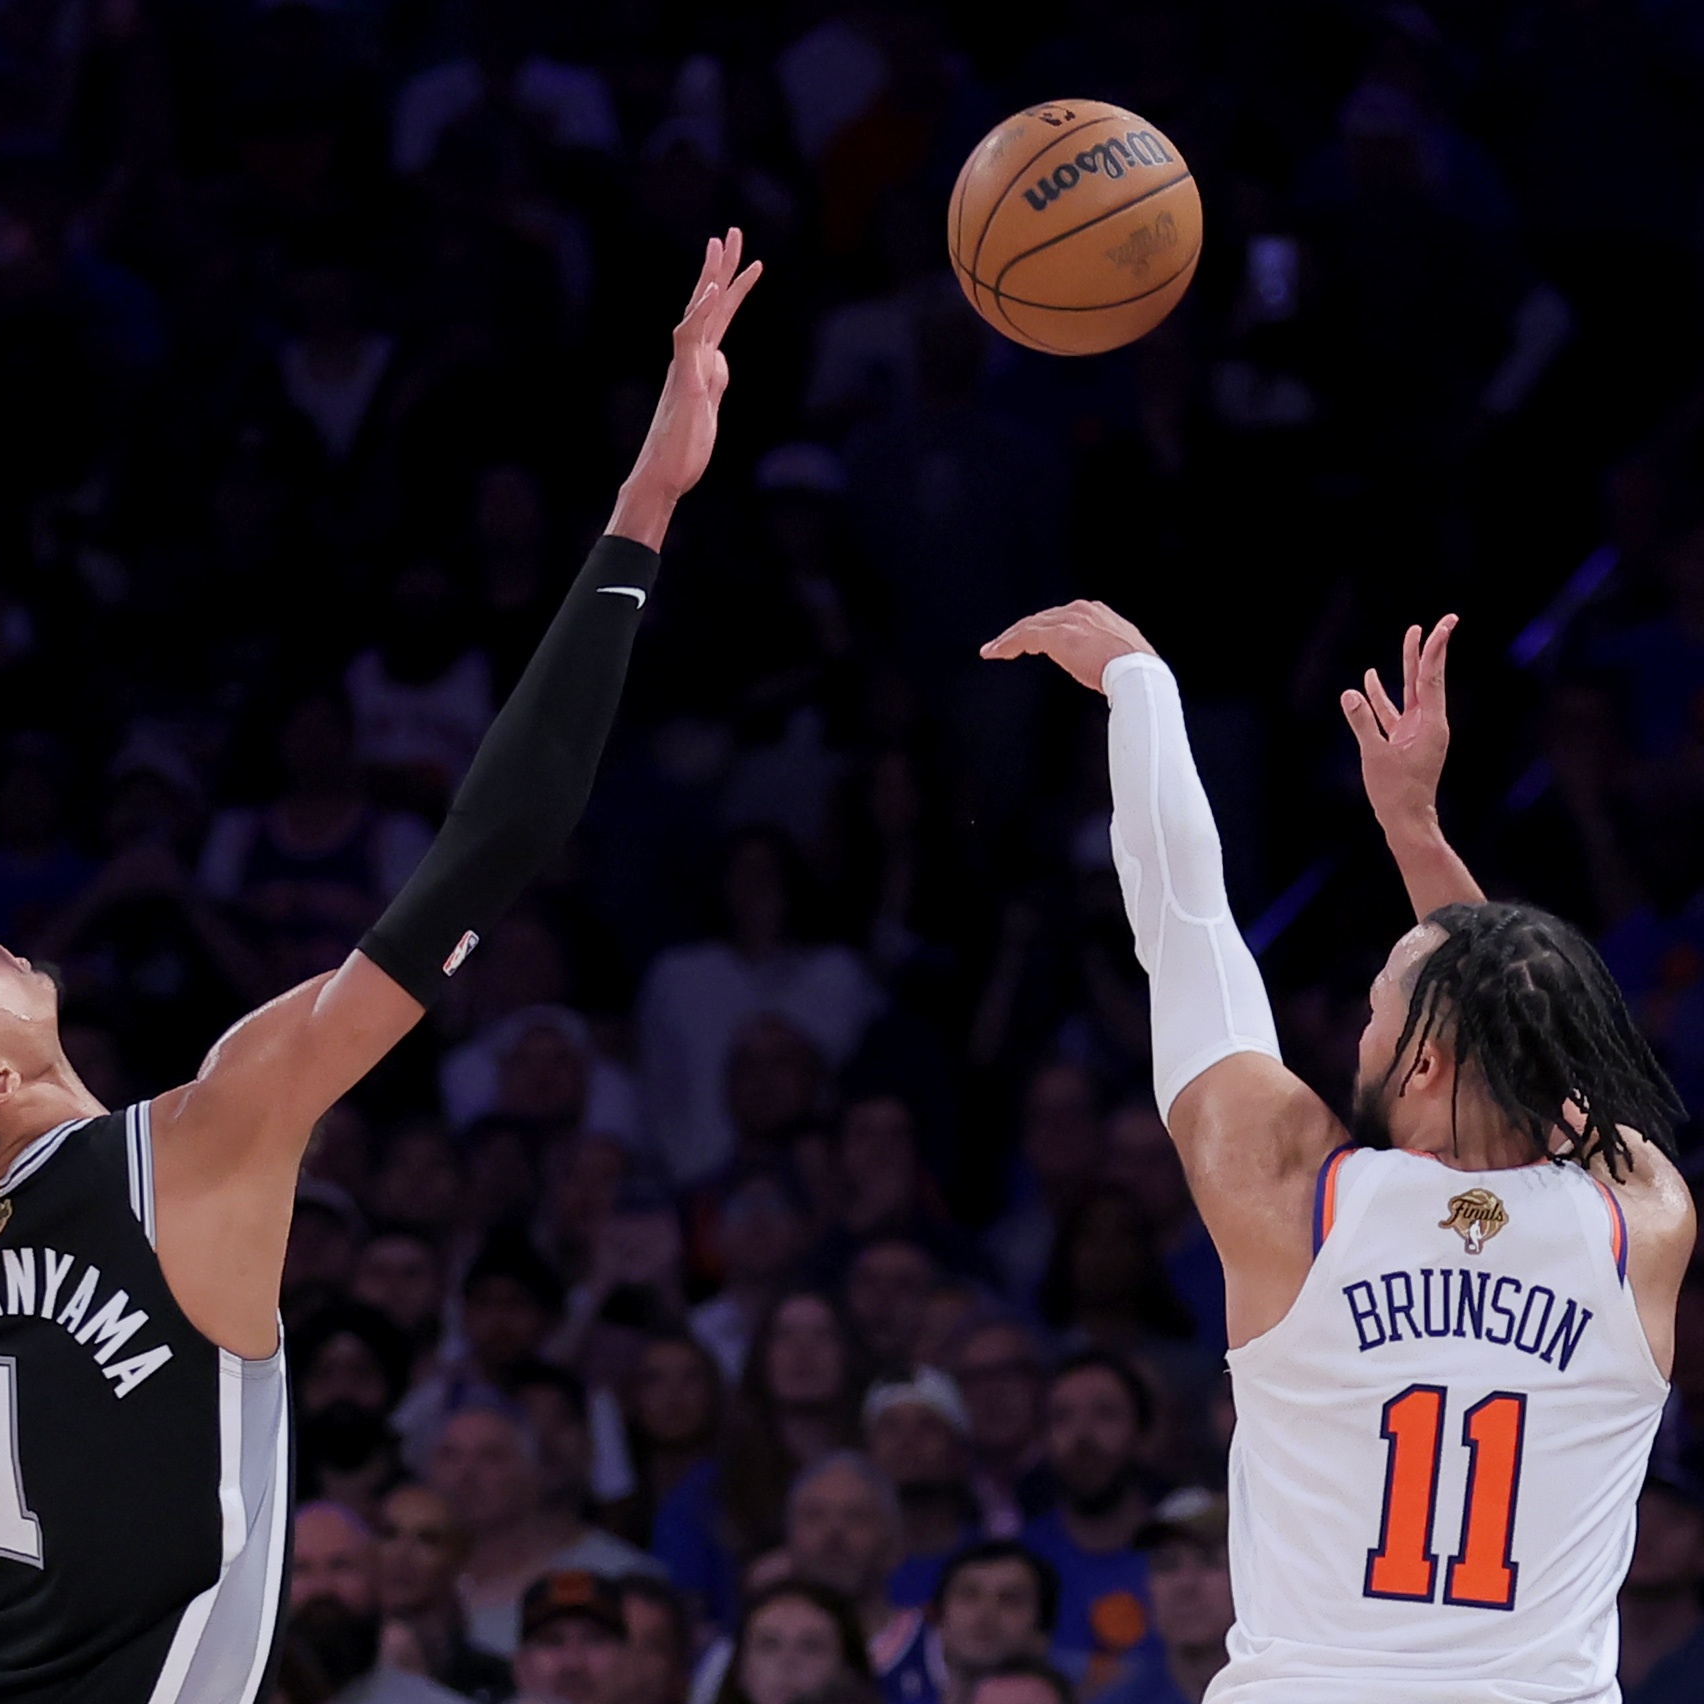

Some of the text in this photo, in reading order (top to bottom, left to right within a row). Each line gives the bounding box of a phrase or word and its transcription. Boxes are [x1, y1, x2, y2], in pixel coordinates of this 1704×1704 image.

[1022, 129, 1175, 212] Wilson
[1440, 1198, 1504, 1227] Finals
[1342, 1268, 1594, 1373] BRUNSON
[1362, 1383, 1528, 1612] 11
